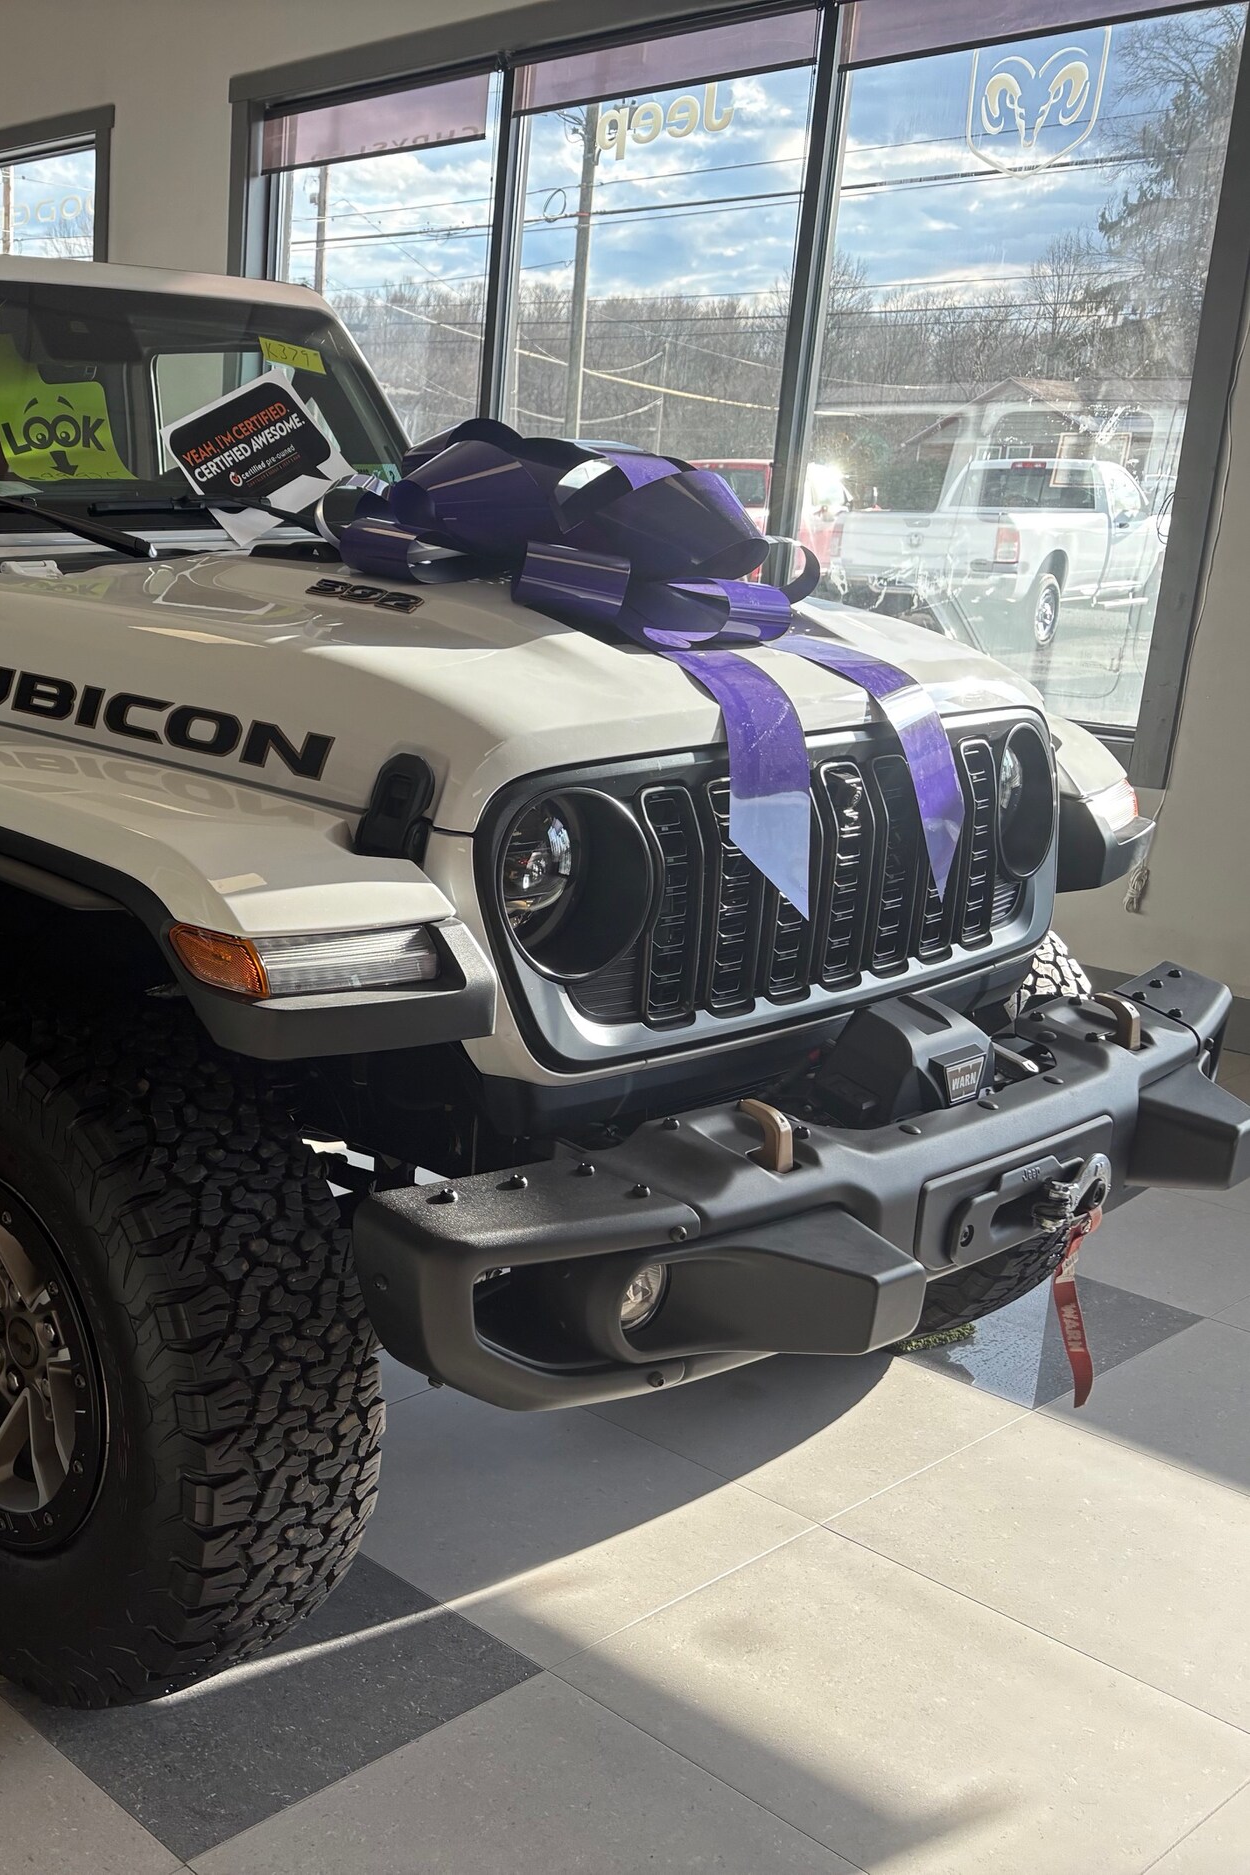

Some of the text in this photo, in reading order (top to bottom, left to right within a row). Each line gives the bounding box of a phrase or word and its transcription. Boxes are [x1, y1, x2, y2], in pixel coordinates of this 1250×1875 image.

[1, 414, 106, 456] LOOK
[182, 400, 290, 467] YEAH, I'M CERTIFIED.
[193, 412, 306, 482] CERTIFIED AWESOME.
[241, 443, 296, 480] certified pre-owned
[305, 578, 425, 614] 392
[951, 1070, 978, 1092] WARN
[1021, 1166, 1041, 1183] Jeep
[1060, 1302, 1086, 1353] WARN
